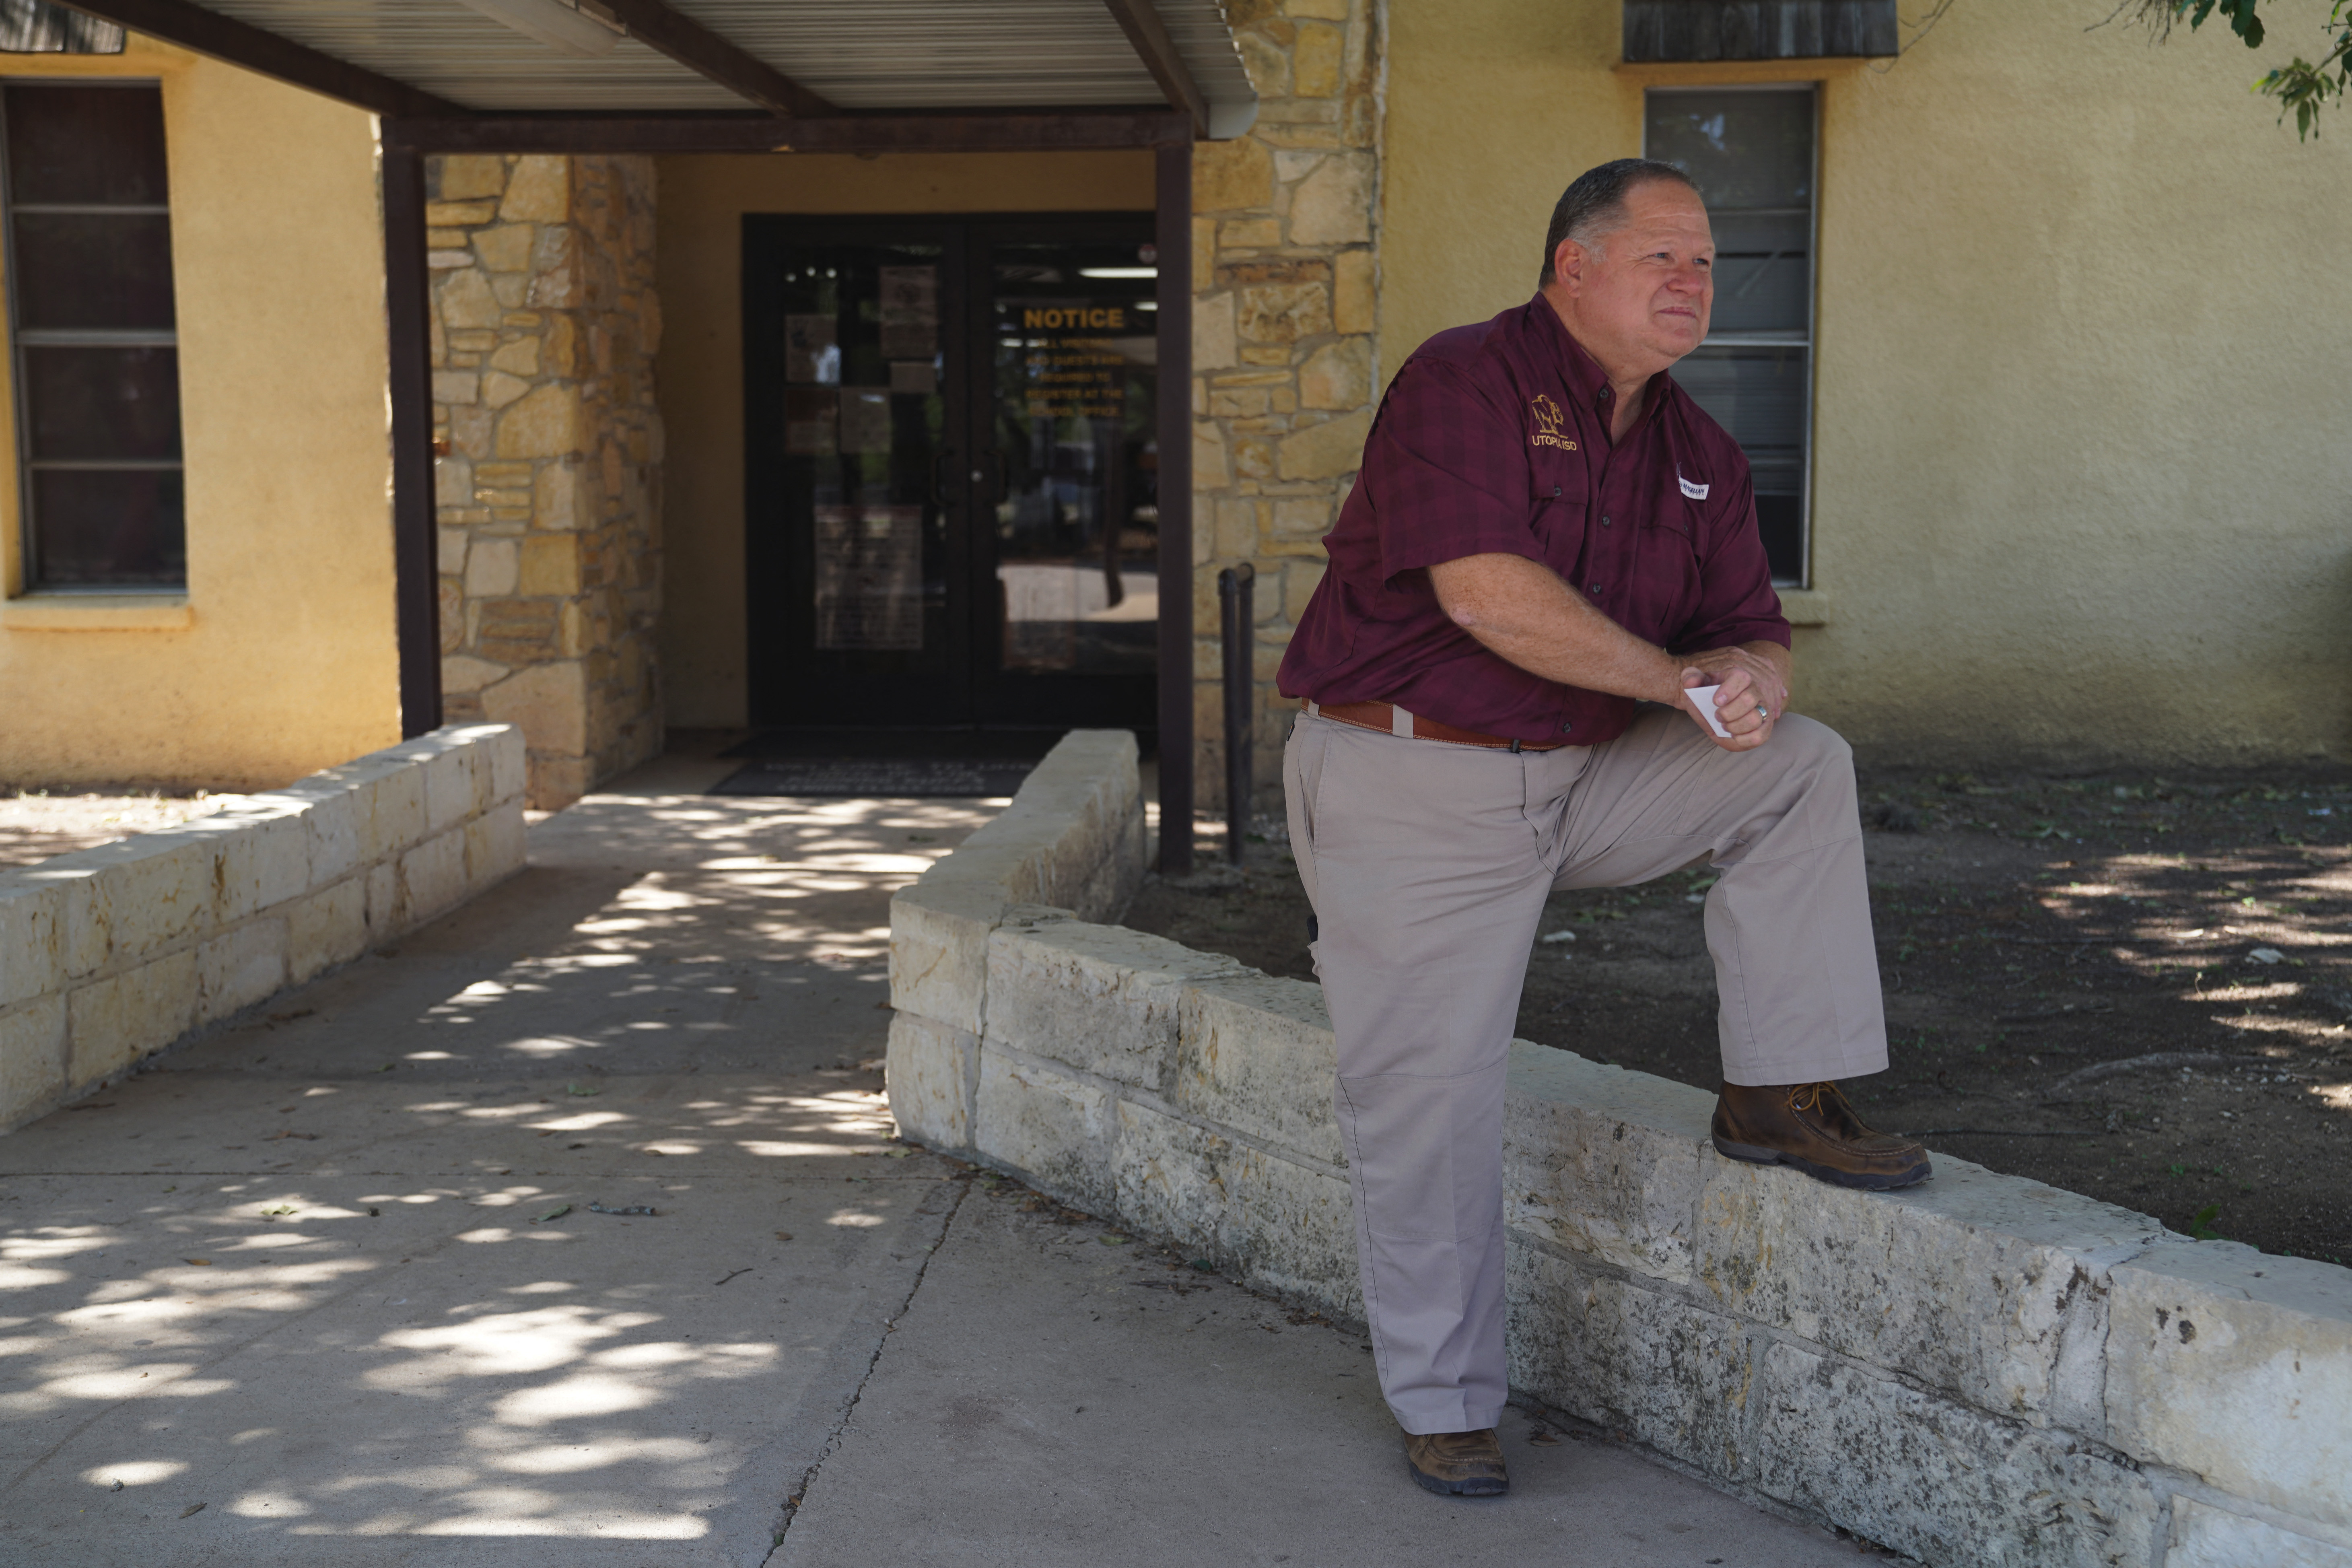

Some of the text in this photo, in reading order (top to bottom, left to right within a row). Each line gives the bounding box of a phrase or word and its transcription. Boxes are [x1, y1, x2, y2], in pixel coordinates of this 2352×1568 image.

[1024, 308, 1125, 329] NOTICE
[1532, 435, 1577, 451] UTOPIA ISD
[1682, 483, 1705, 494] MAGELLAN
